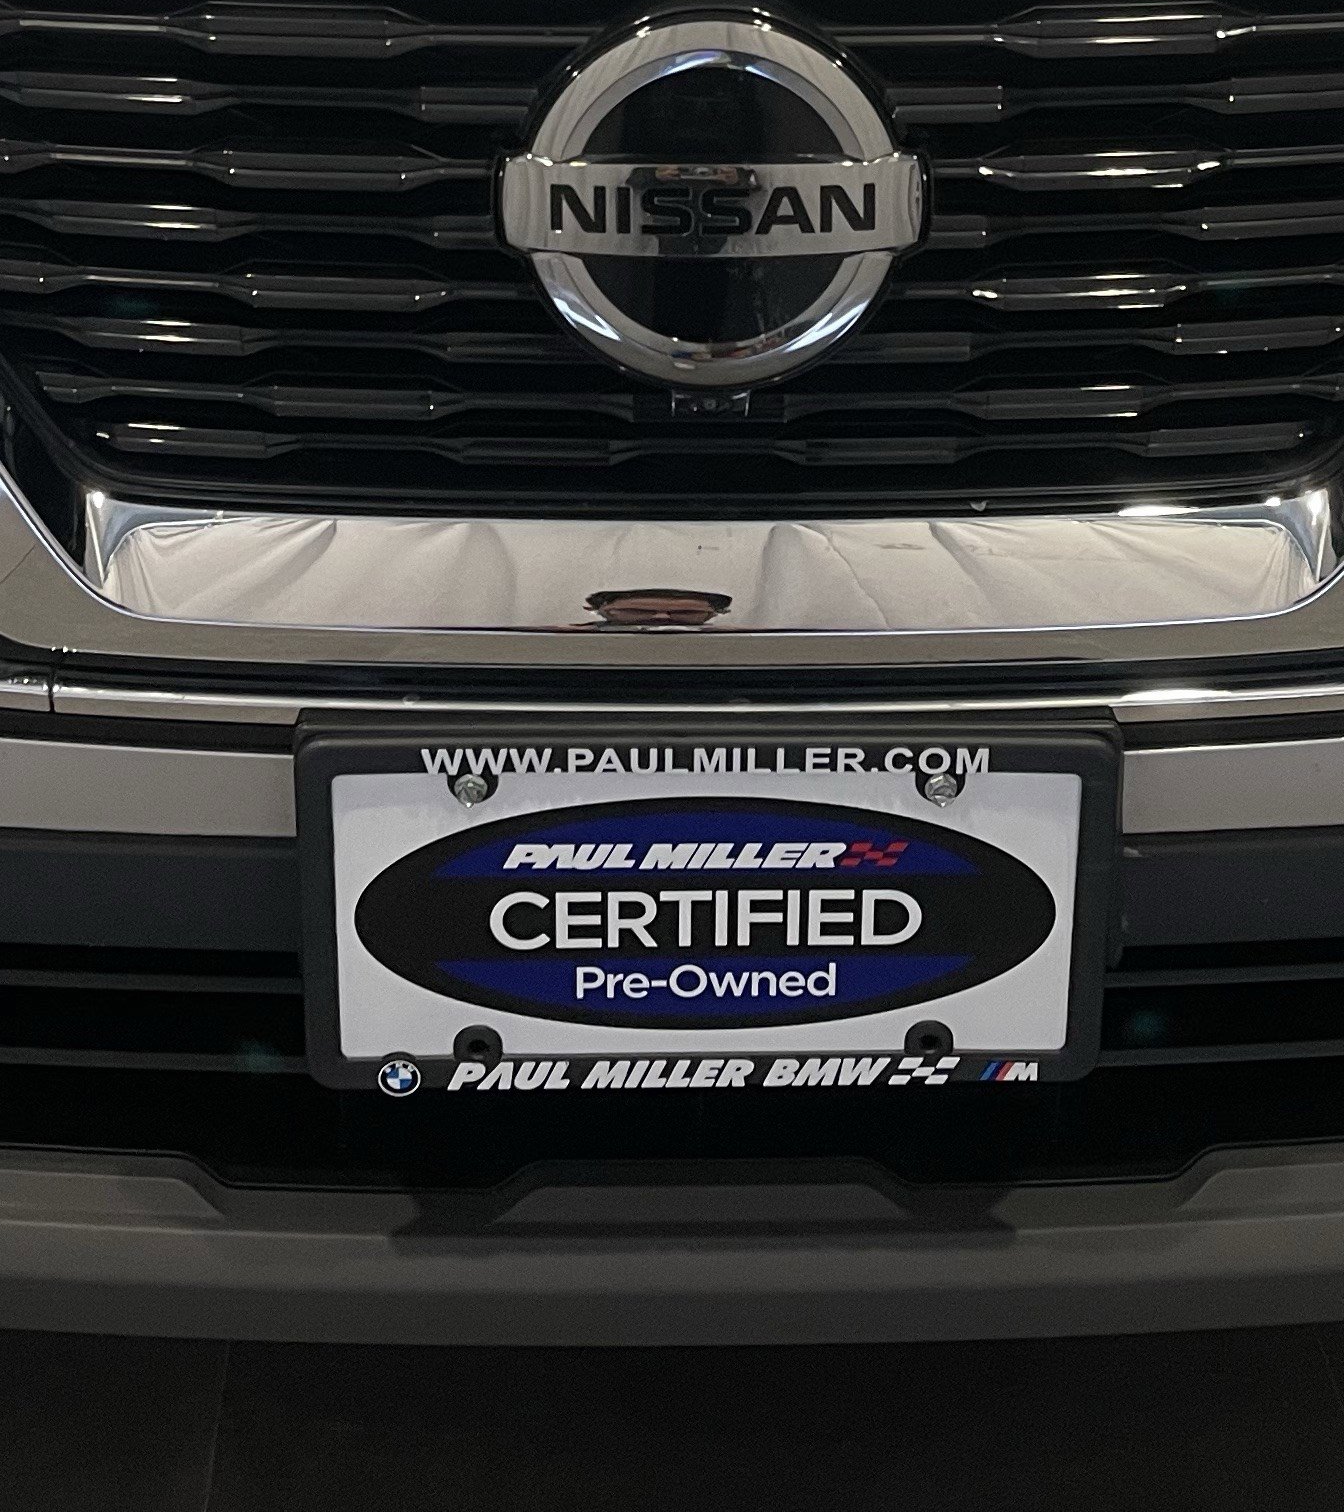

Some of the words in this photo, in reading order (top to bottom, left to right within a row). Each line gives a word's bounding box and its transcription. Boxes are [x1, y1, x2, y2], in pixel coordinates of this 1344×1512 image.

[549, 183, 876, 236] NISSAN
[420, 747, 990, 776] WWW.PAULMILLER.COM
[503, 843, 636, 870] PAUL
[638, 842, 847, 869] MILLER
[489, 889, 923, 950] CERTIFIED
[575, 962, 837, 1000] Pre-Owned
[447, 1061, 570, 1091] PAUL
[581, 1059, 755, 1089] MILLER
[763, 1057, 892, 1086] BMW
[1003, 1062, 1039, 1082] M
